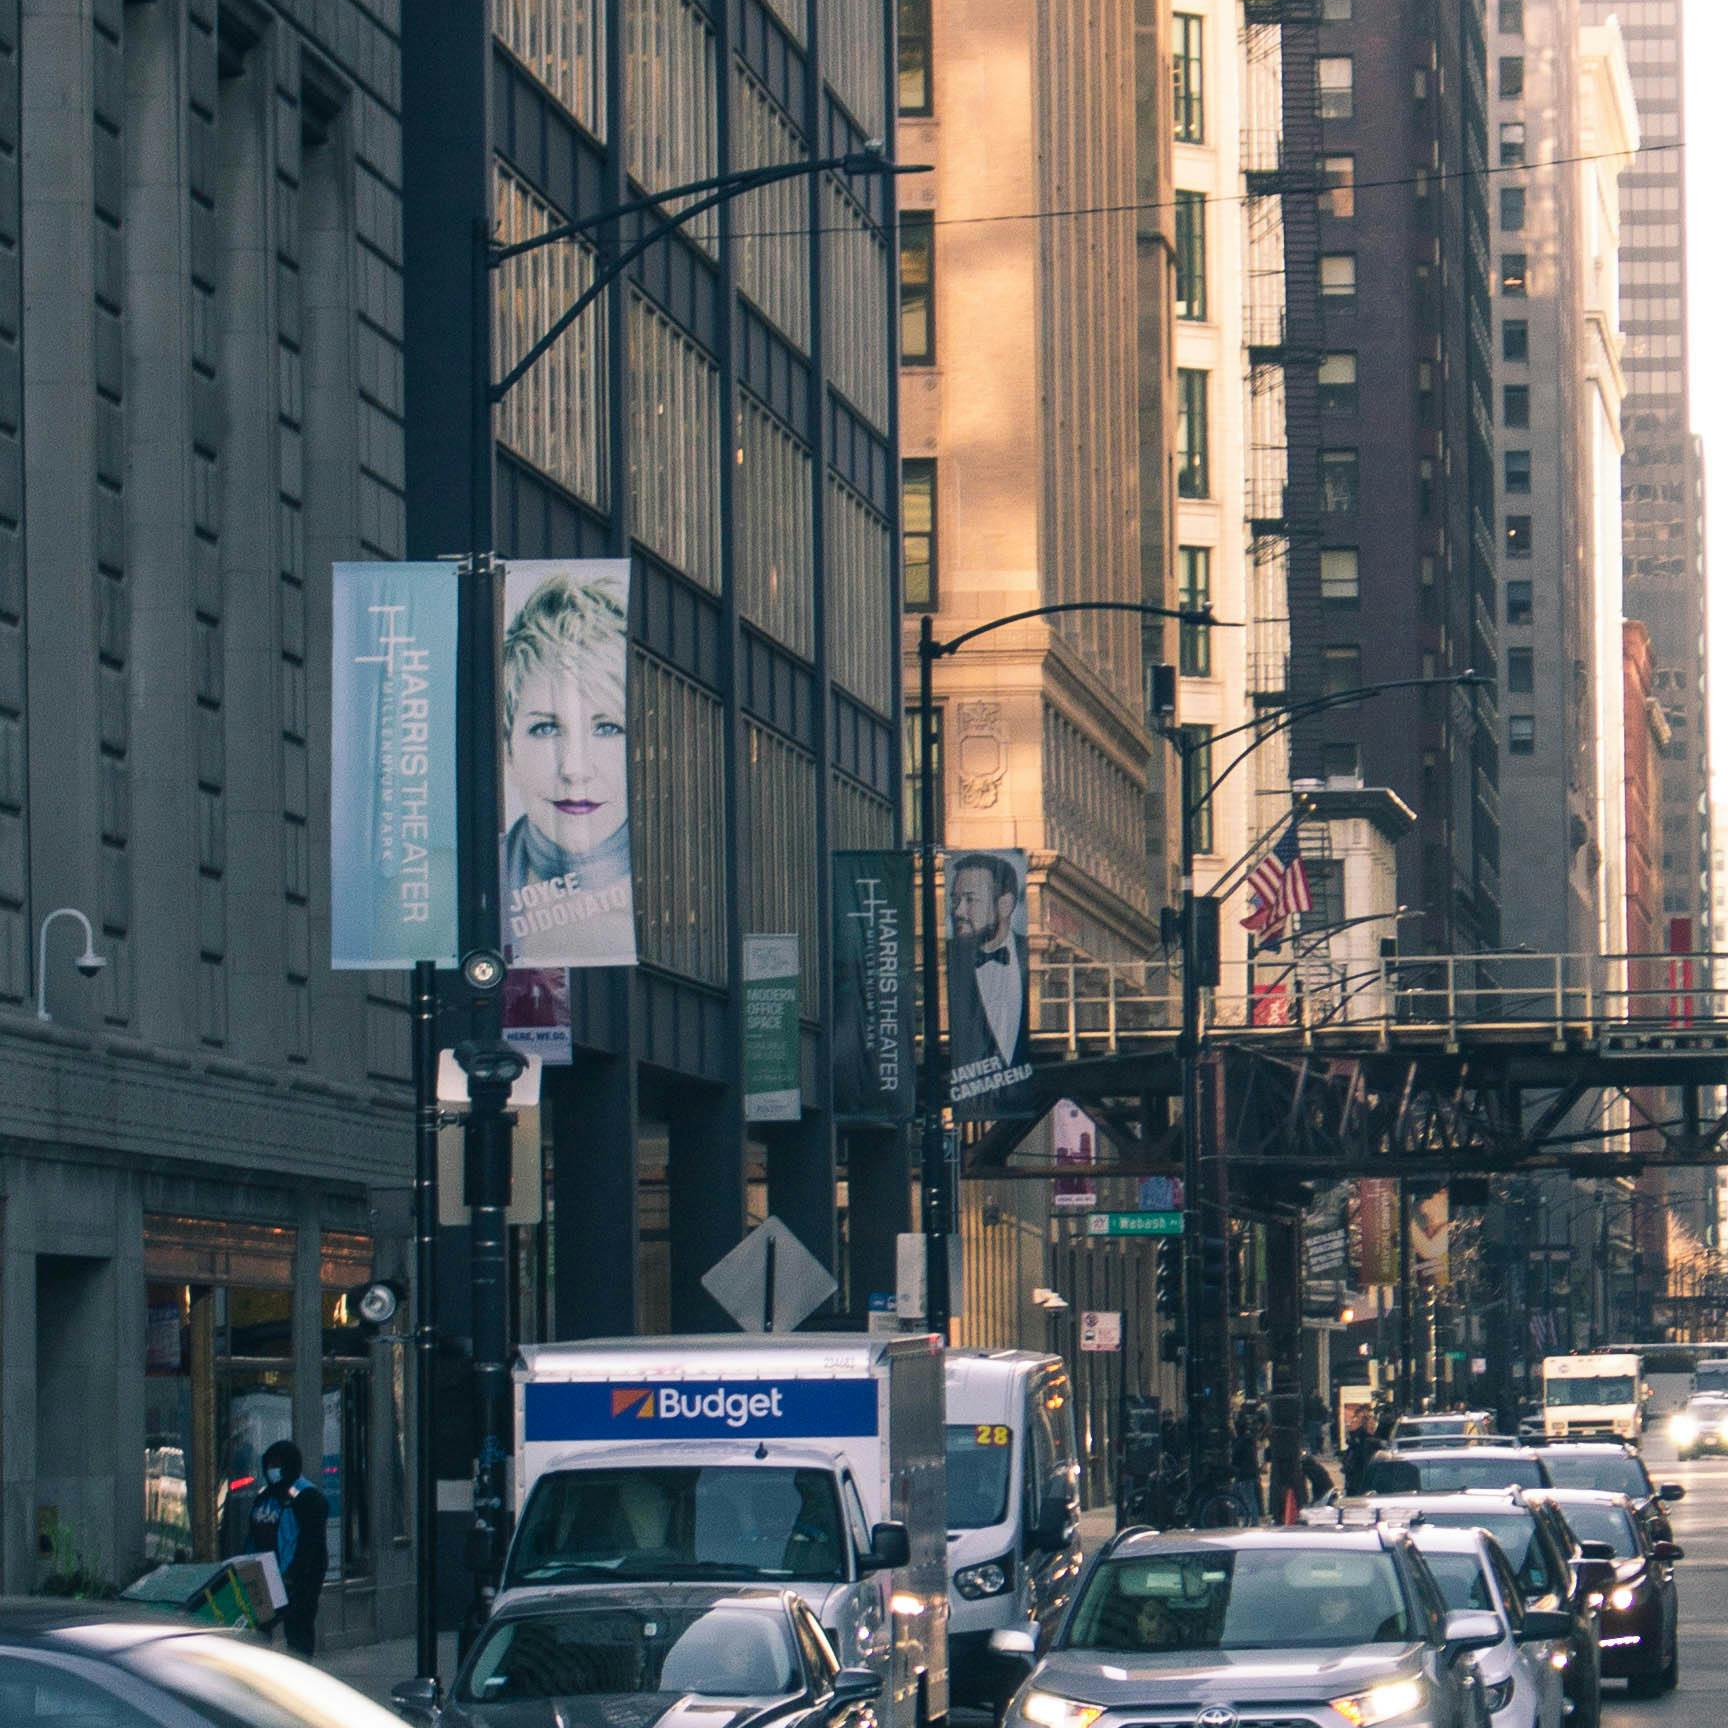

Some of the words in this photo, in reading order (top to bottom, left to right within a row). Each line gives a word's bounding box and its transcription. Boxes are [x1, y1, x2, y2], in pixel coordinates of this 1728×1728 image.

[401, 649, 429, 777] HARRIS
[382, 812, 393, 861] PARK
[401, 780, 429, 924] THEATER
[510, 872, 580, 913] JOYCE
[510, 884, 628, 938] DIDONATO
[879, 909, 898, 993] HARRIS
[746, 988, 796, 1001] MODERN
[746, 1003, 785, 1014] OFFICE
[880, 998, 899, 1092] THEATER
[950, 1055, 1002, 1085] JAVIER
[659, 1387, 783, 1427] Budget
[975, 1425, 1009, 1446] 28
